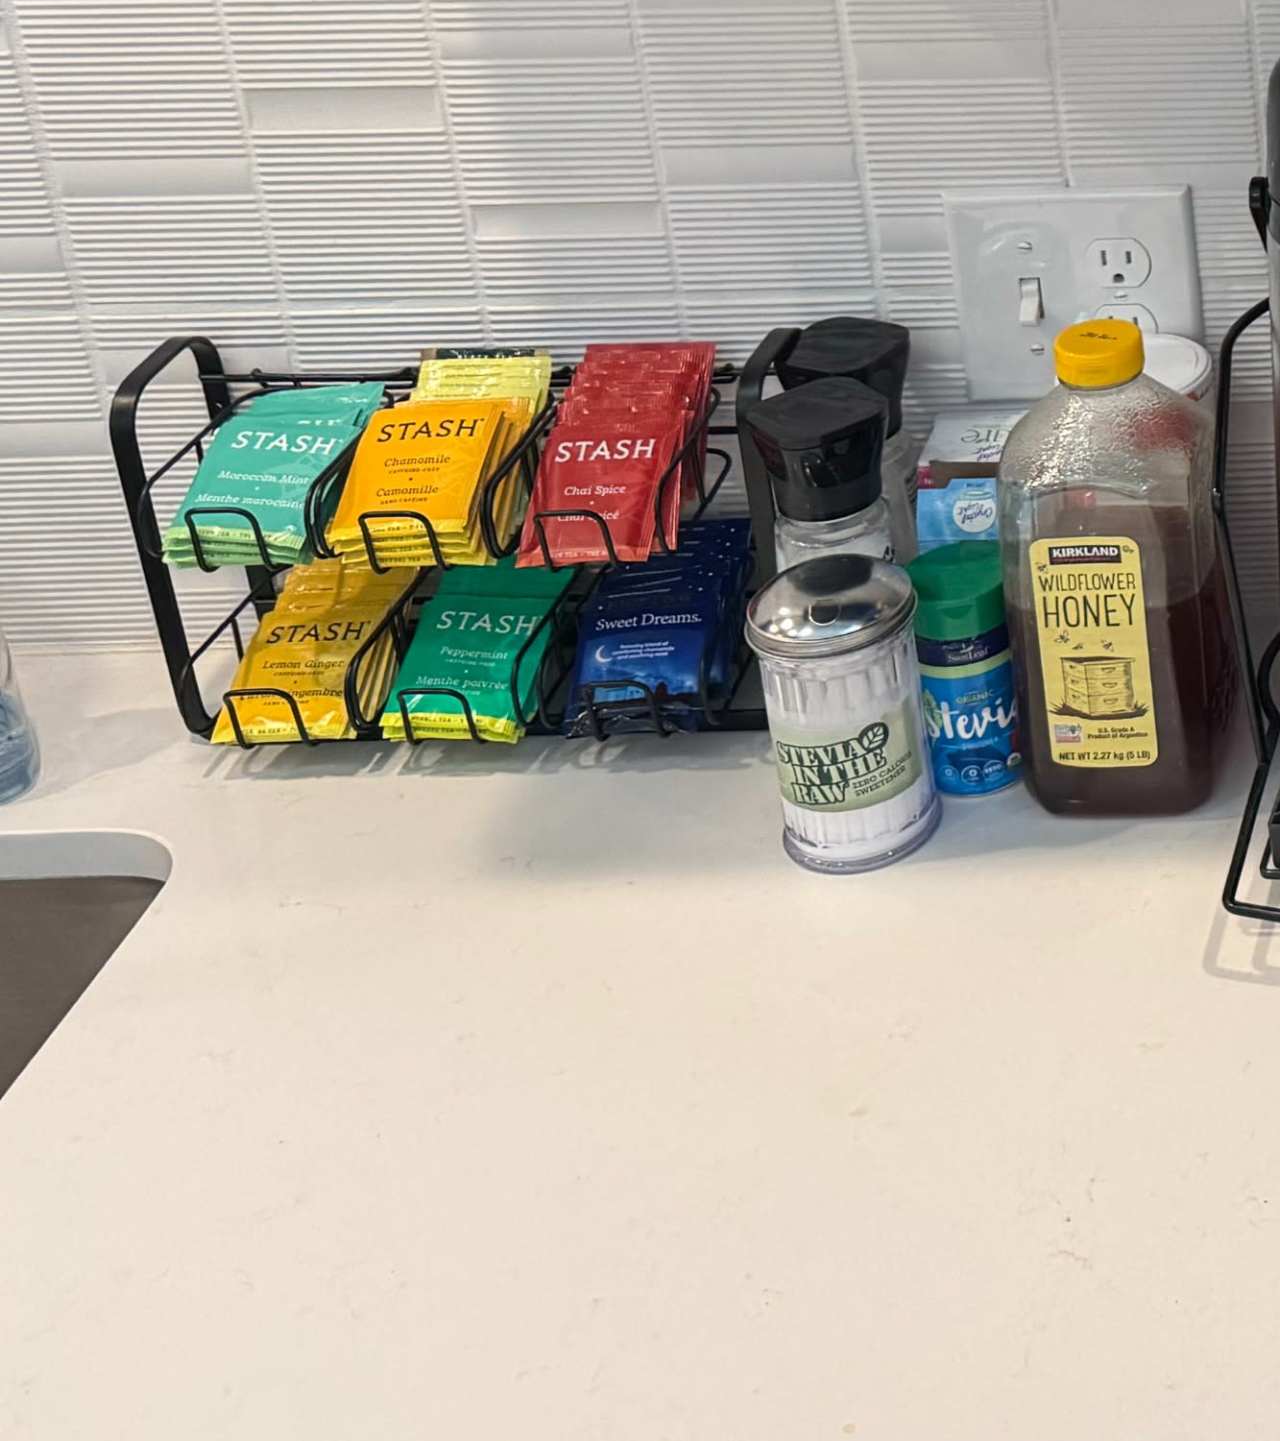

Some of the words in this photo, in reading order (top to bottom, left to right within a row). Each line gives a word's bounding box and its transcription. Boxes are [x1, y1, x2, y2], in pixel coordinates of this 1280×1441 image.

[377, 418, 479, 443] STASH
[231, 431, 337, 455] STASH
[555, 439, 656, 463] STASH
[384, 454, 450, 467] Chamomile
[376, 485, 438, 497] Camomille
[564, 485, 592, 496] Chai
[594, 485, 626, 497] Spice
[1052, 546, 1118, 558] KIRKLAND
[1039, 573, 1136, 592] WILDFLOWER
[1042, 593, 1135, 628] HONEY
[267, 623, 363, 644] STASH
[437, 611, 538, 636] STASH
[595, 617, 638, 631] Sweet
[440, 646, 508, 660] Peppermint
[289, 687, 344, 698] ingembre
[776, 737, 867, 766] STEVIA
[1060, 752, 1075, 760] NET
[1078, 752, 1091, 760] WT
[793, 764, 821, 785] IN
[824, 748, 887, 783] THE
[791, 781, 847, 805] RAW
